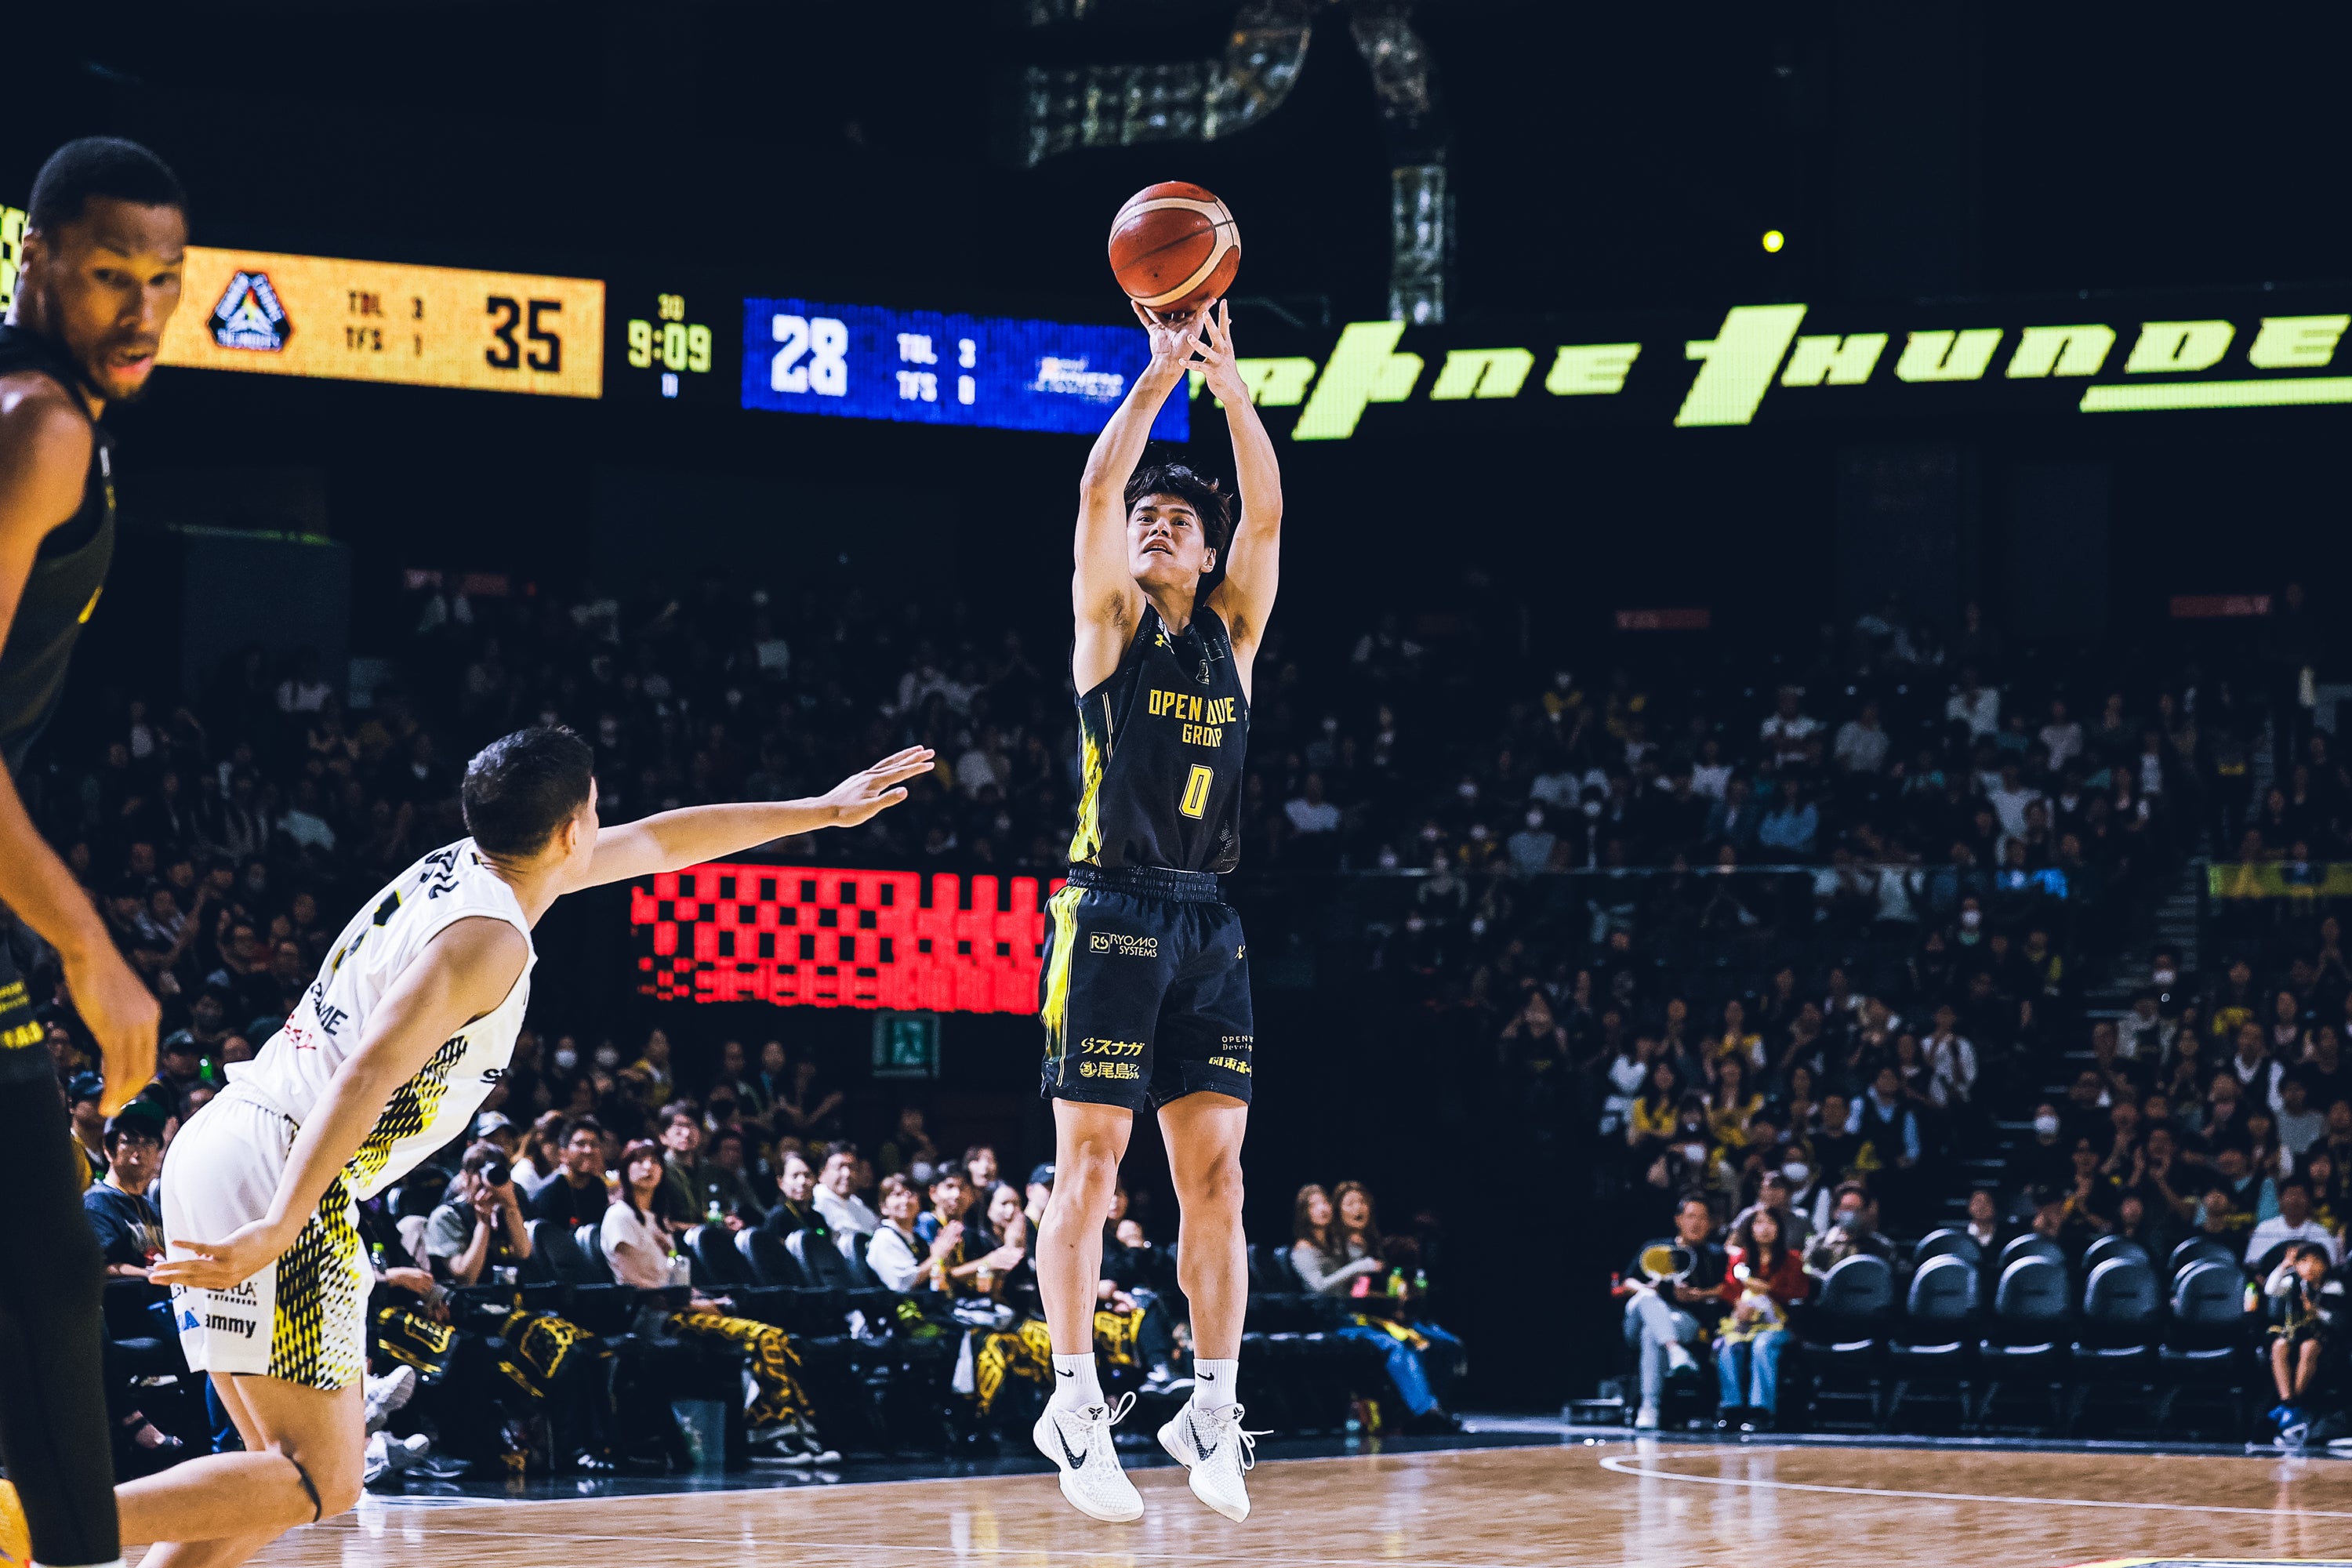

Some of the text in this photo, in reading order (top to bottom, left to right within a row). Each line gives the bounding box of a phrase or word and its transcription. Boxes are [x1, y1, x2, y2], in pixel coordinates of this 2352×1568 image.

[486, 296, 562, 373] 35
[628, 318, 712, 373] 9:09
[771, 314, 848, 397] 28
[1149, 689, 1203, 722] OPEN
[1178, 764, 1214, 820] 0
[1110, 934, 1158, 949] RYOMO
[1119, 946, 1158, 958] SYSTEMS
